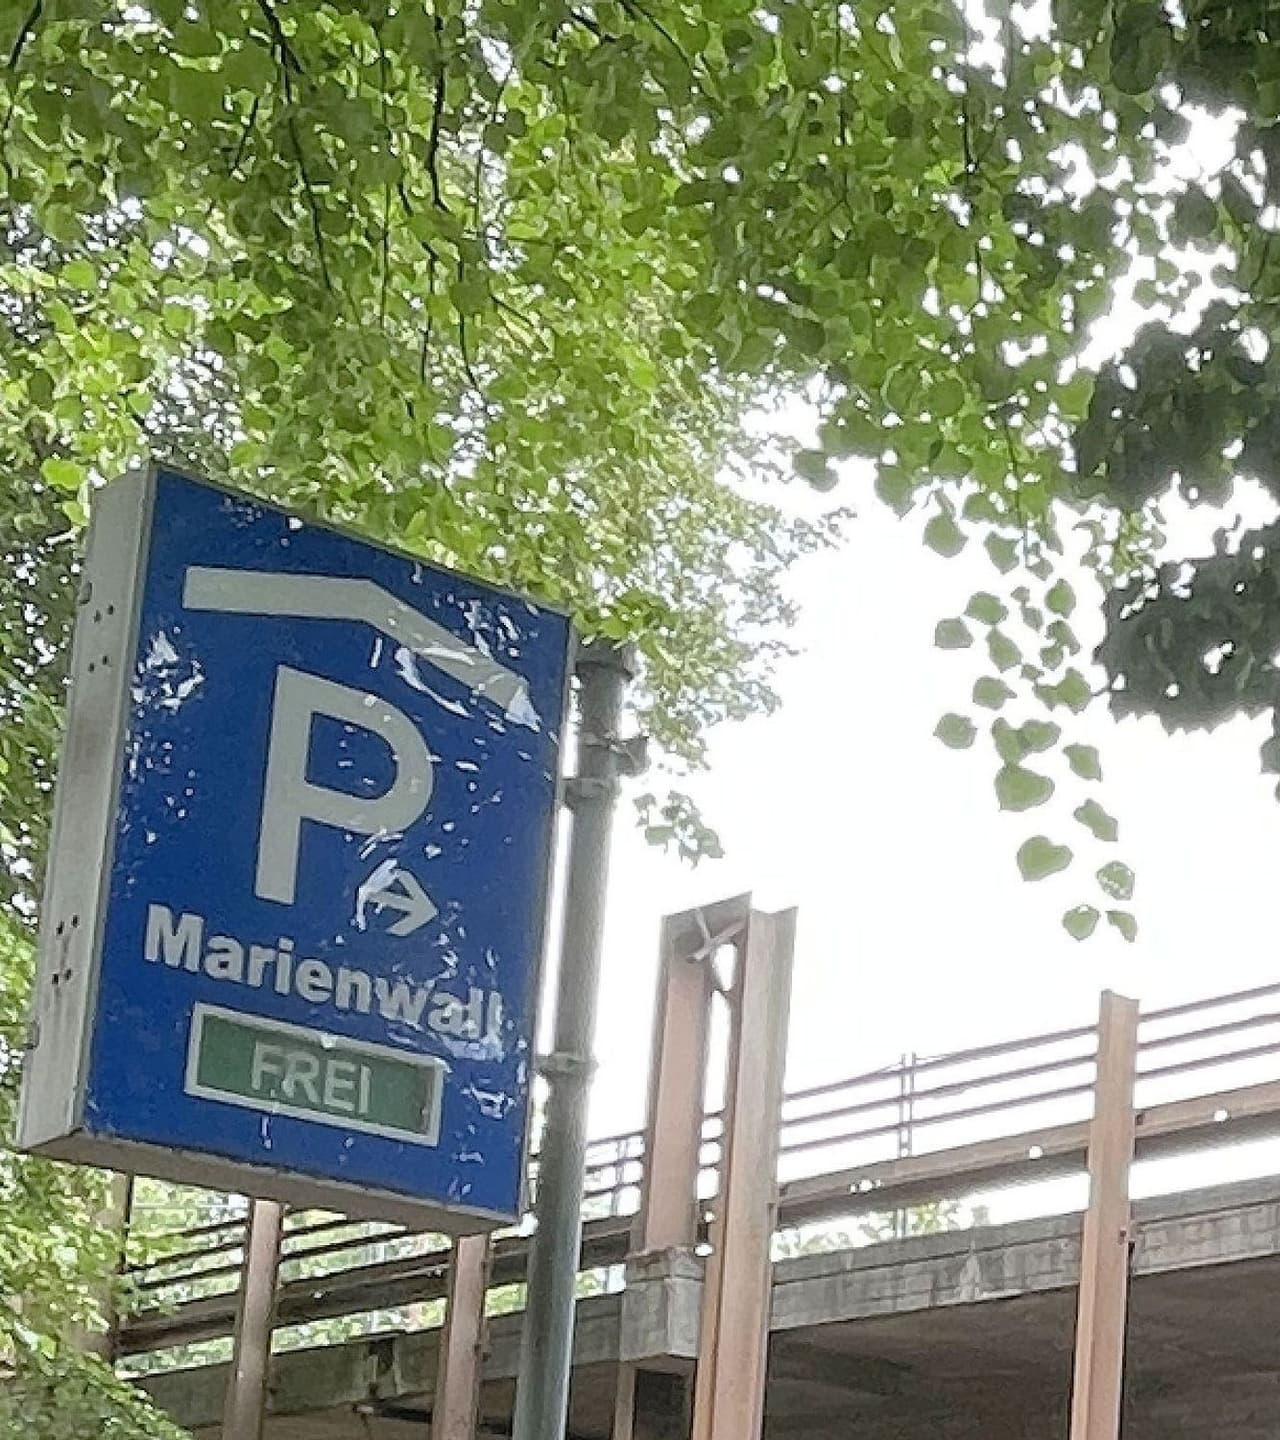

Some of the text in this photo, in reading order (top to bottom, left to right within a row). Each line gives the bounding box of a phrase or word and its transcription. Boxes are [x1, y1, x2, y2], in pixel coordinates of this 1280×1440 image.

[254, 664, 436, 905] P
[144, 903, 502, 1042] Marienwall
[250, 1041, 371, 1114] FREI
